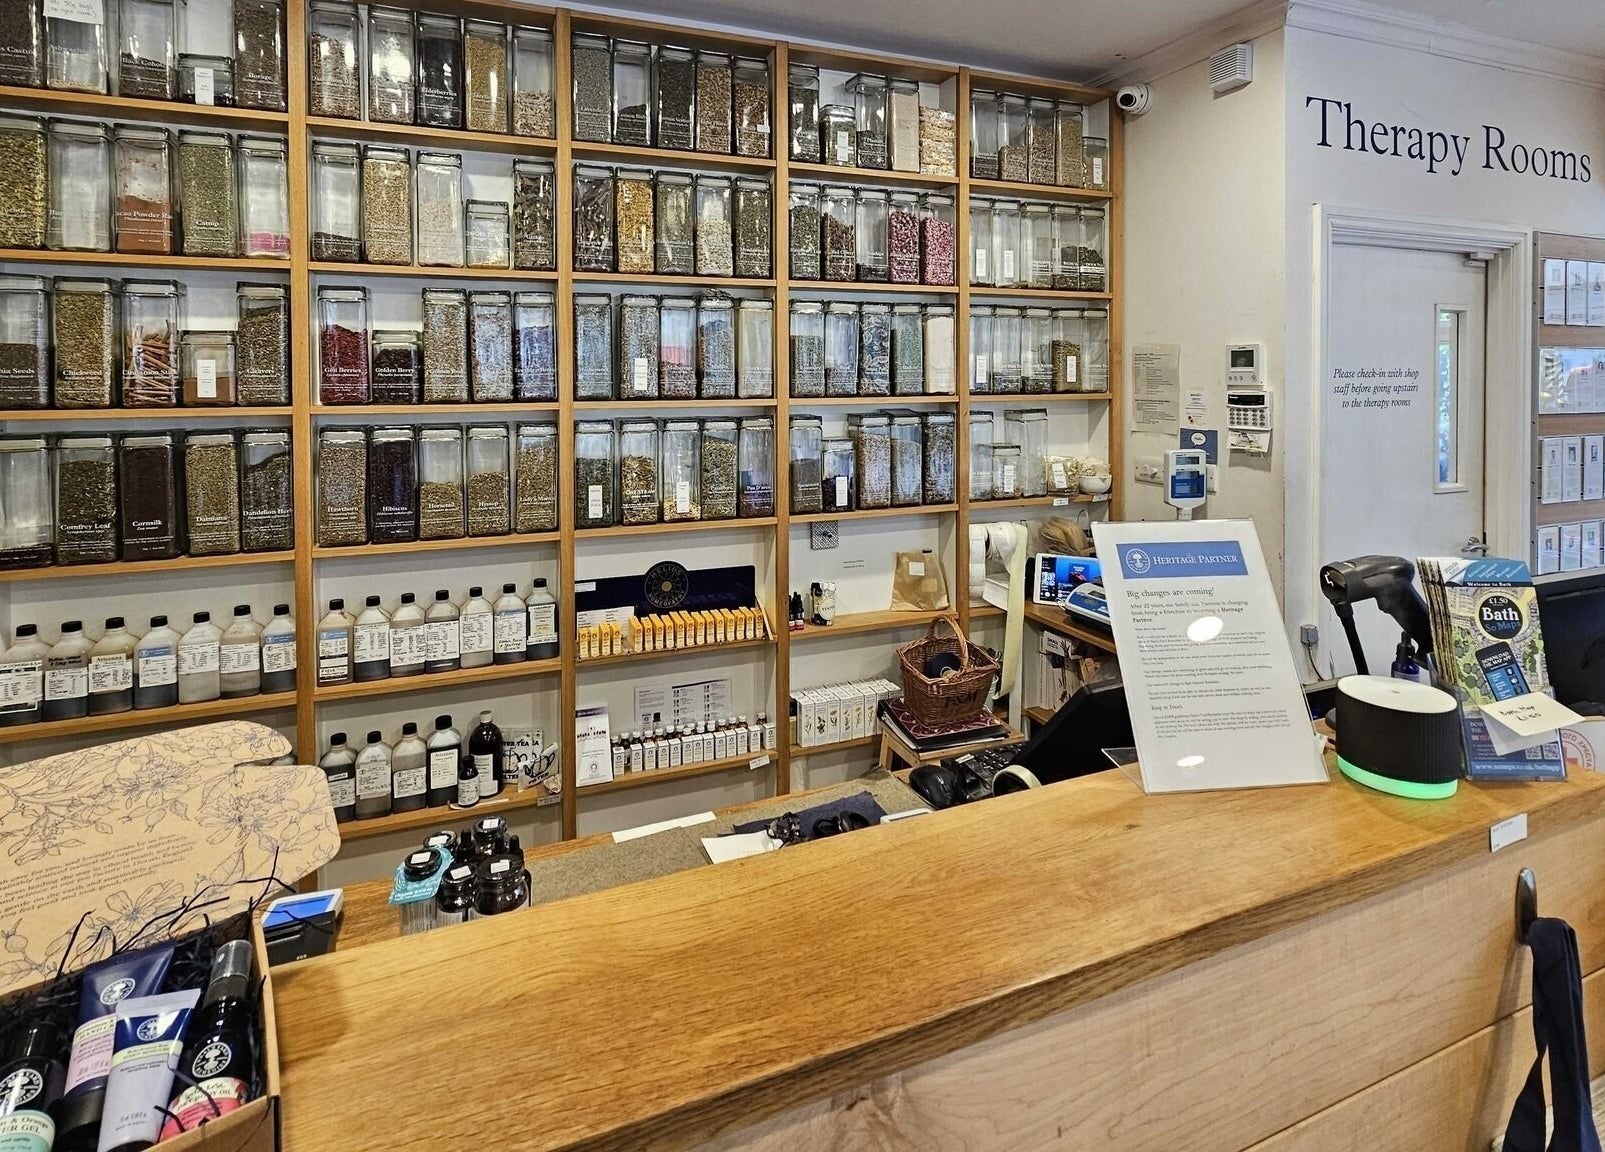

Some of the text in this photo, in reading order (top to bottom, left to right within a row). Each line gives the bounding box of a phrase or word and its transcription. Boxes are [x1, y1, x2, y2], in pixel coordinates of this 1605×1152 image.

[248, 72, 272, 81] Borage
[421, 86, 457, 97] Elderberries
[1306, 96, 1592, 184] Therapy Rooms
[132, 211, 160, 219] Powder
[195, 220, 220, 228] Catnip
[12, 367, 36, 375] Seeds
[62, 369, 103, 377] Chickweed
[397, 367, 415, 375] Berry
[1333, 368, 1420, 380] Please check-in with shop
[1333, 383, 1419, 396] staff before going upstairs
[1342, 397, 1411, 409] to the therapy rooms
[478, 501, 499, 509] Hyssop
[243, 508, 276, 517] Dandelion
[132, 520, 163, 528] Cornsilk
[196, 515, 228, 523] Damiana
[60, 521, 112, 532] Comfrey Leaf
[1152, 554, 1239, 566] HERITAGE PARTNER
[650, 565, 683, 580] HELIOS
[647, 589, 686, 608] HOMEOPATHY
[1126, 589, 1140, 599] Big
[1141, 589, 1170, 599] changes
[1186, 587, 1215, 597] coming!
[1488, 596, 1509, 605] £1.50
[1221, 607, 1244, 615] Heritage
[1481, 606, 1520, 621] Bath
[1485, 619, 1522, 633] So Maps
[516, 740, 530, 748] TEA
[528, 771, 550, 786] FILTER
[20, 1123, 42, 1135] GEL
